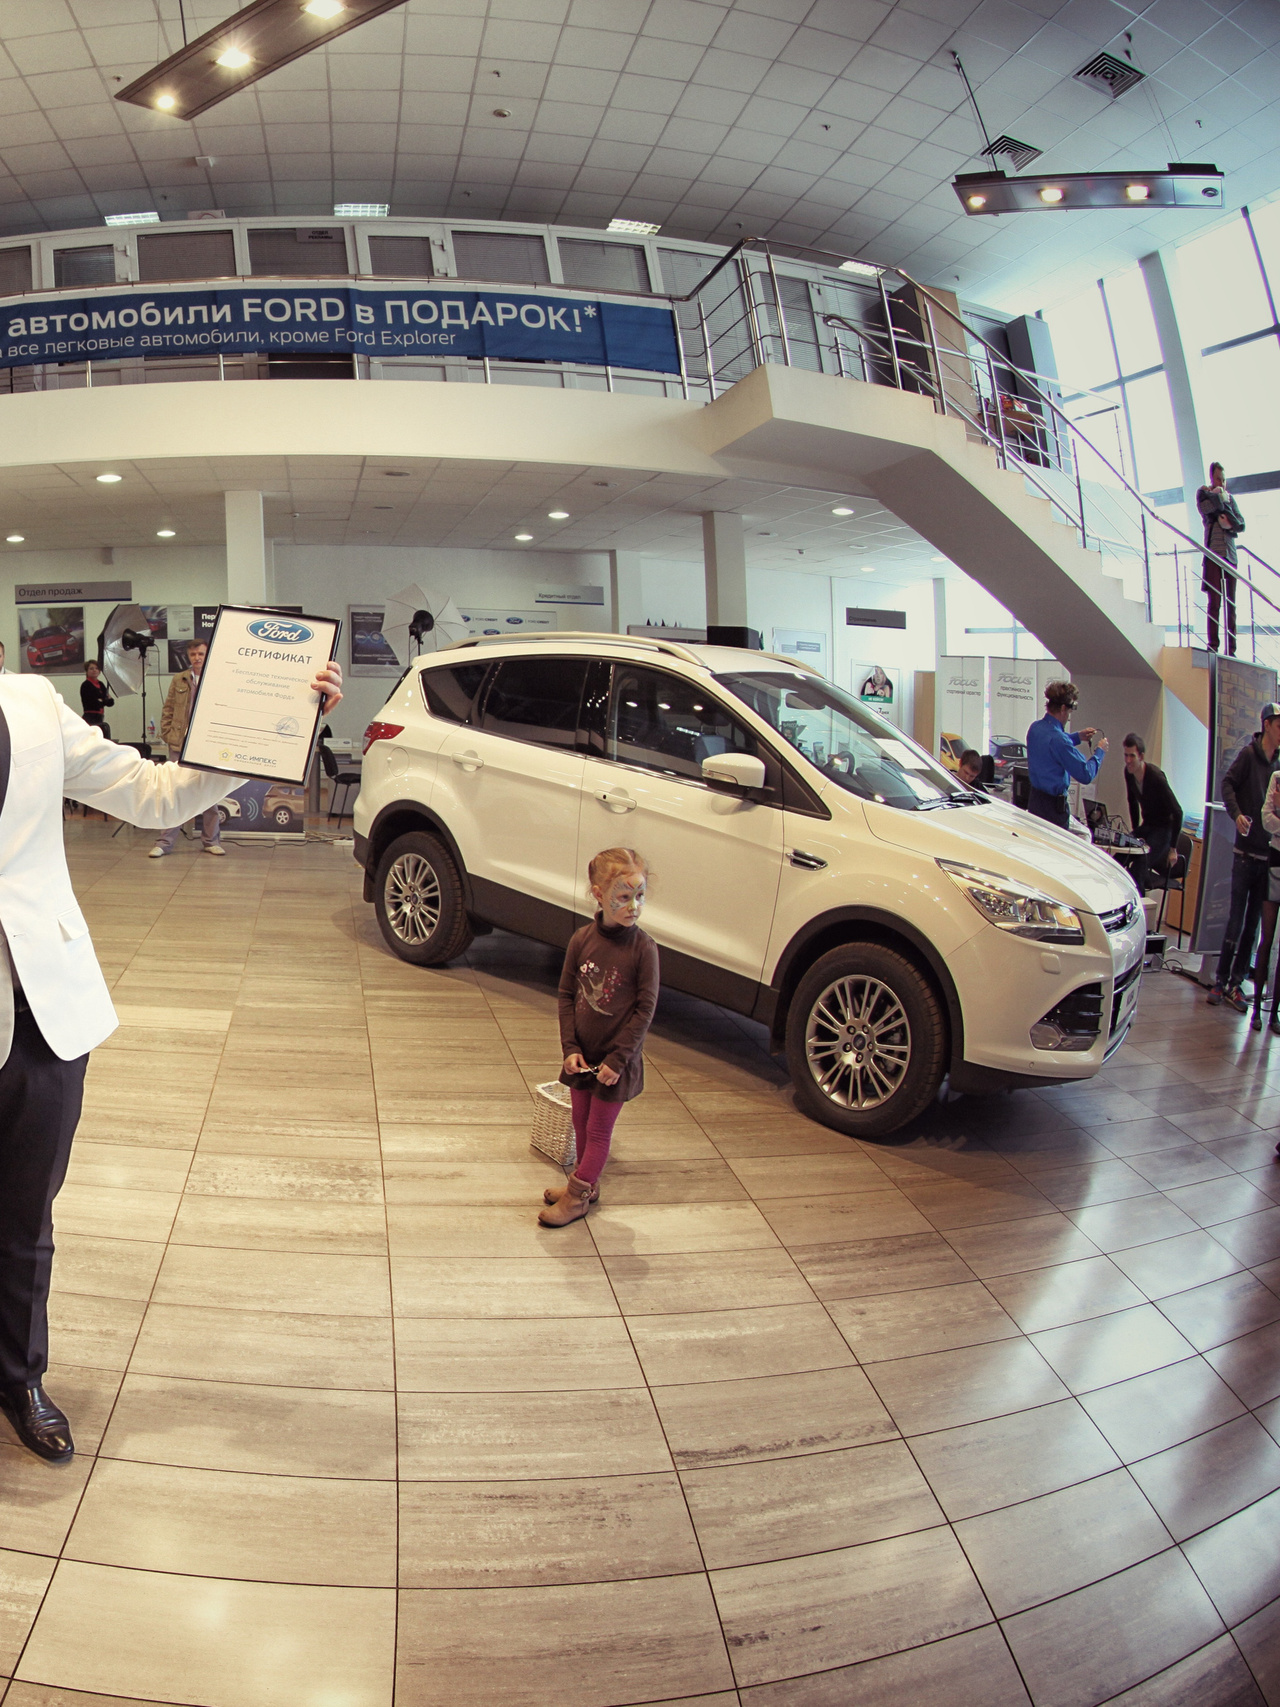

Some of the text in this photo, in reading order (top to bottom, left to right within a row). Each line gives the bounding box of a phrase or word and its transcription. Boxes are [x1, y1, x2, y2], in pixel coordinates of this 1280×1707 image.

[7, 301, 232, 337] автомобили
[242, 297, 345, 322] FORD
[355, 303, 375, 324] в
[8, 342, 39, 357] все
[44, 334, 135, 354] легковые
[140, 328, 265, 347] автомобили,
[269, 330, 329, 346] кроме
[335, 327, 376, 346] Ford
[381, 330, 456, 348] Explorer
[18, 587, 83, 597] Отдел продаж
[538, 592, 566, 600] Кредитный
[257, 621, 303, 641] Ford
[237, 647, 312, 665] СЕРТИФИКАТ
